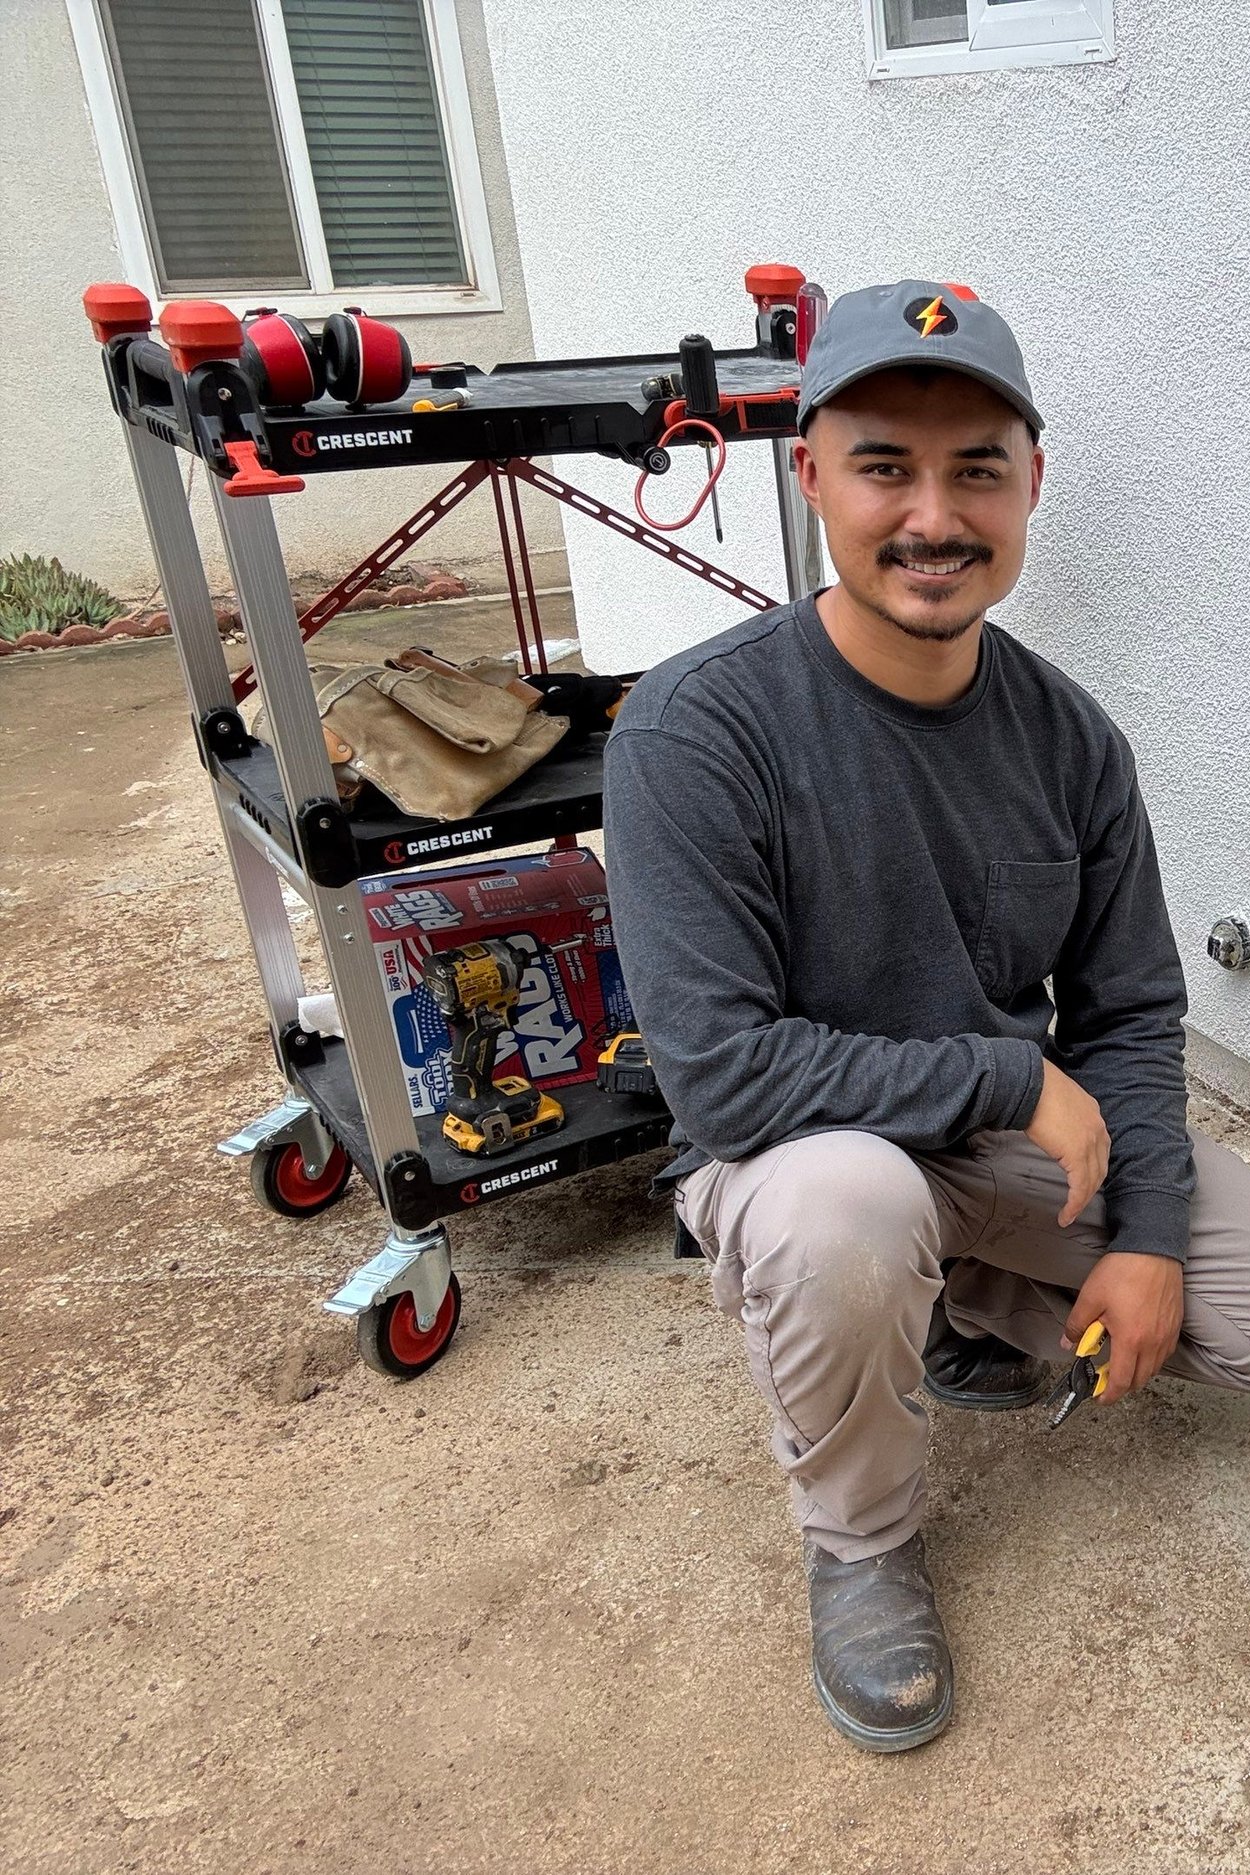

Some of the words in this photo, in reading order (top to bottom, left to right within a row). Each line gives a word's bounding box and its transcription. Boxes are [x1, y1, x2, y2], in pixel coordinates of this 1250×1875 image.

[316, 429, 413, 450] CRESCENT
[406, 826, 493, 856] CRESCENT
[394, 889, 464, 931] RAGS
[601, 924, 613, 947] Thick
[383, 949, 397, 976] USA
[551, 973, 563, 992] LIKE
[556, 992, 574, 1023] WORKS
[408, 1076, 423, 1108] SELLARS
[428, 1054, 448, 1103] TOOL
[480, 1159, 559, 1194] CRESCENT
